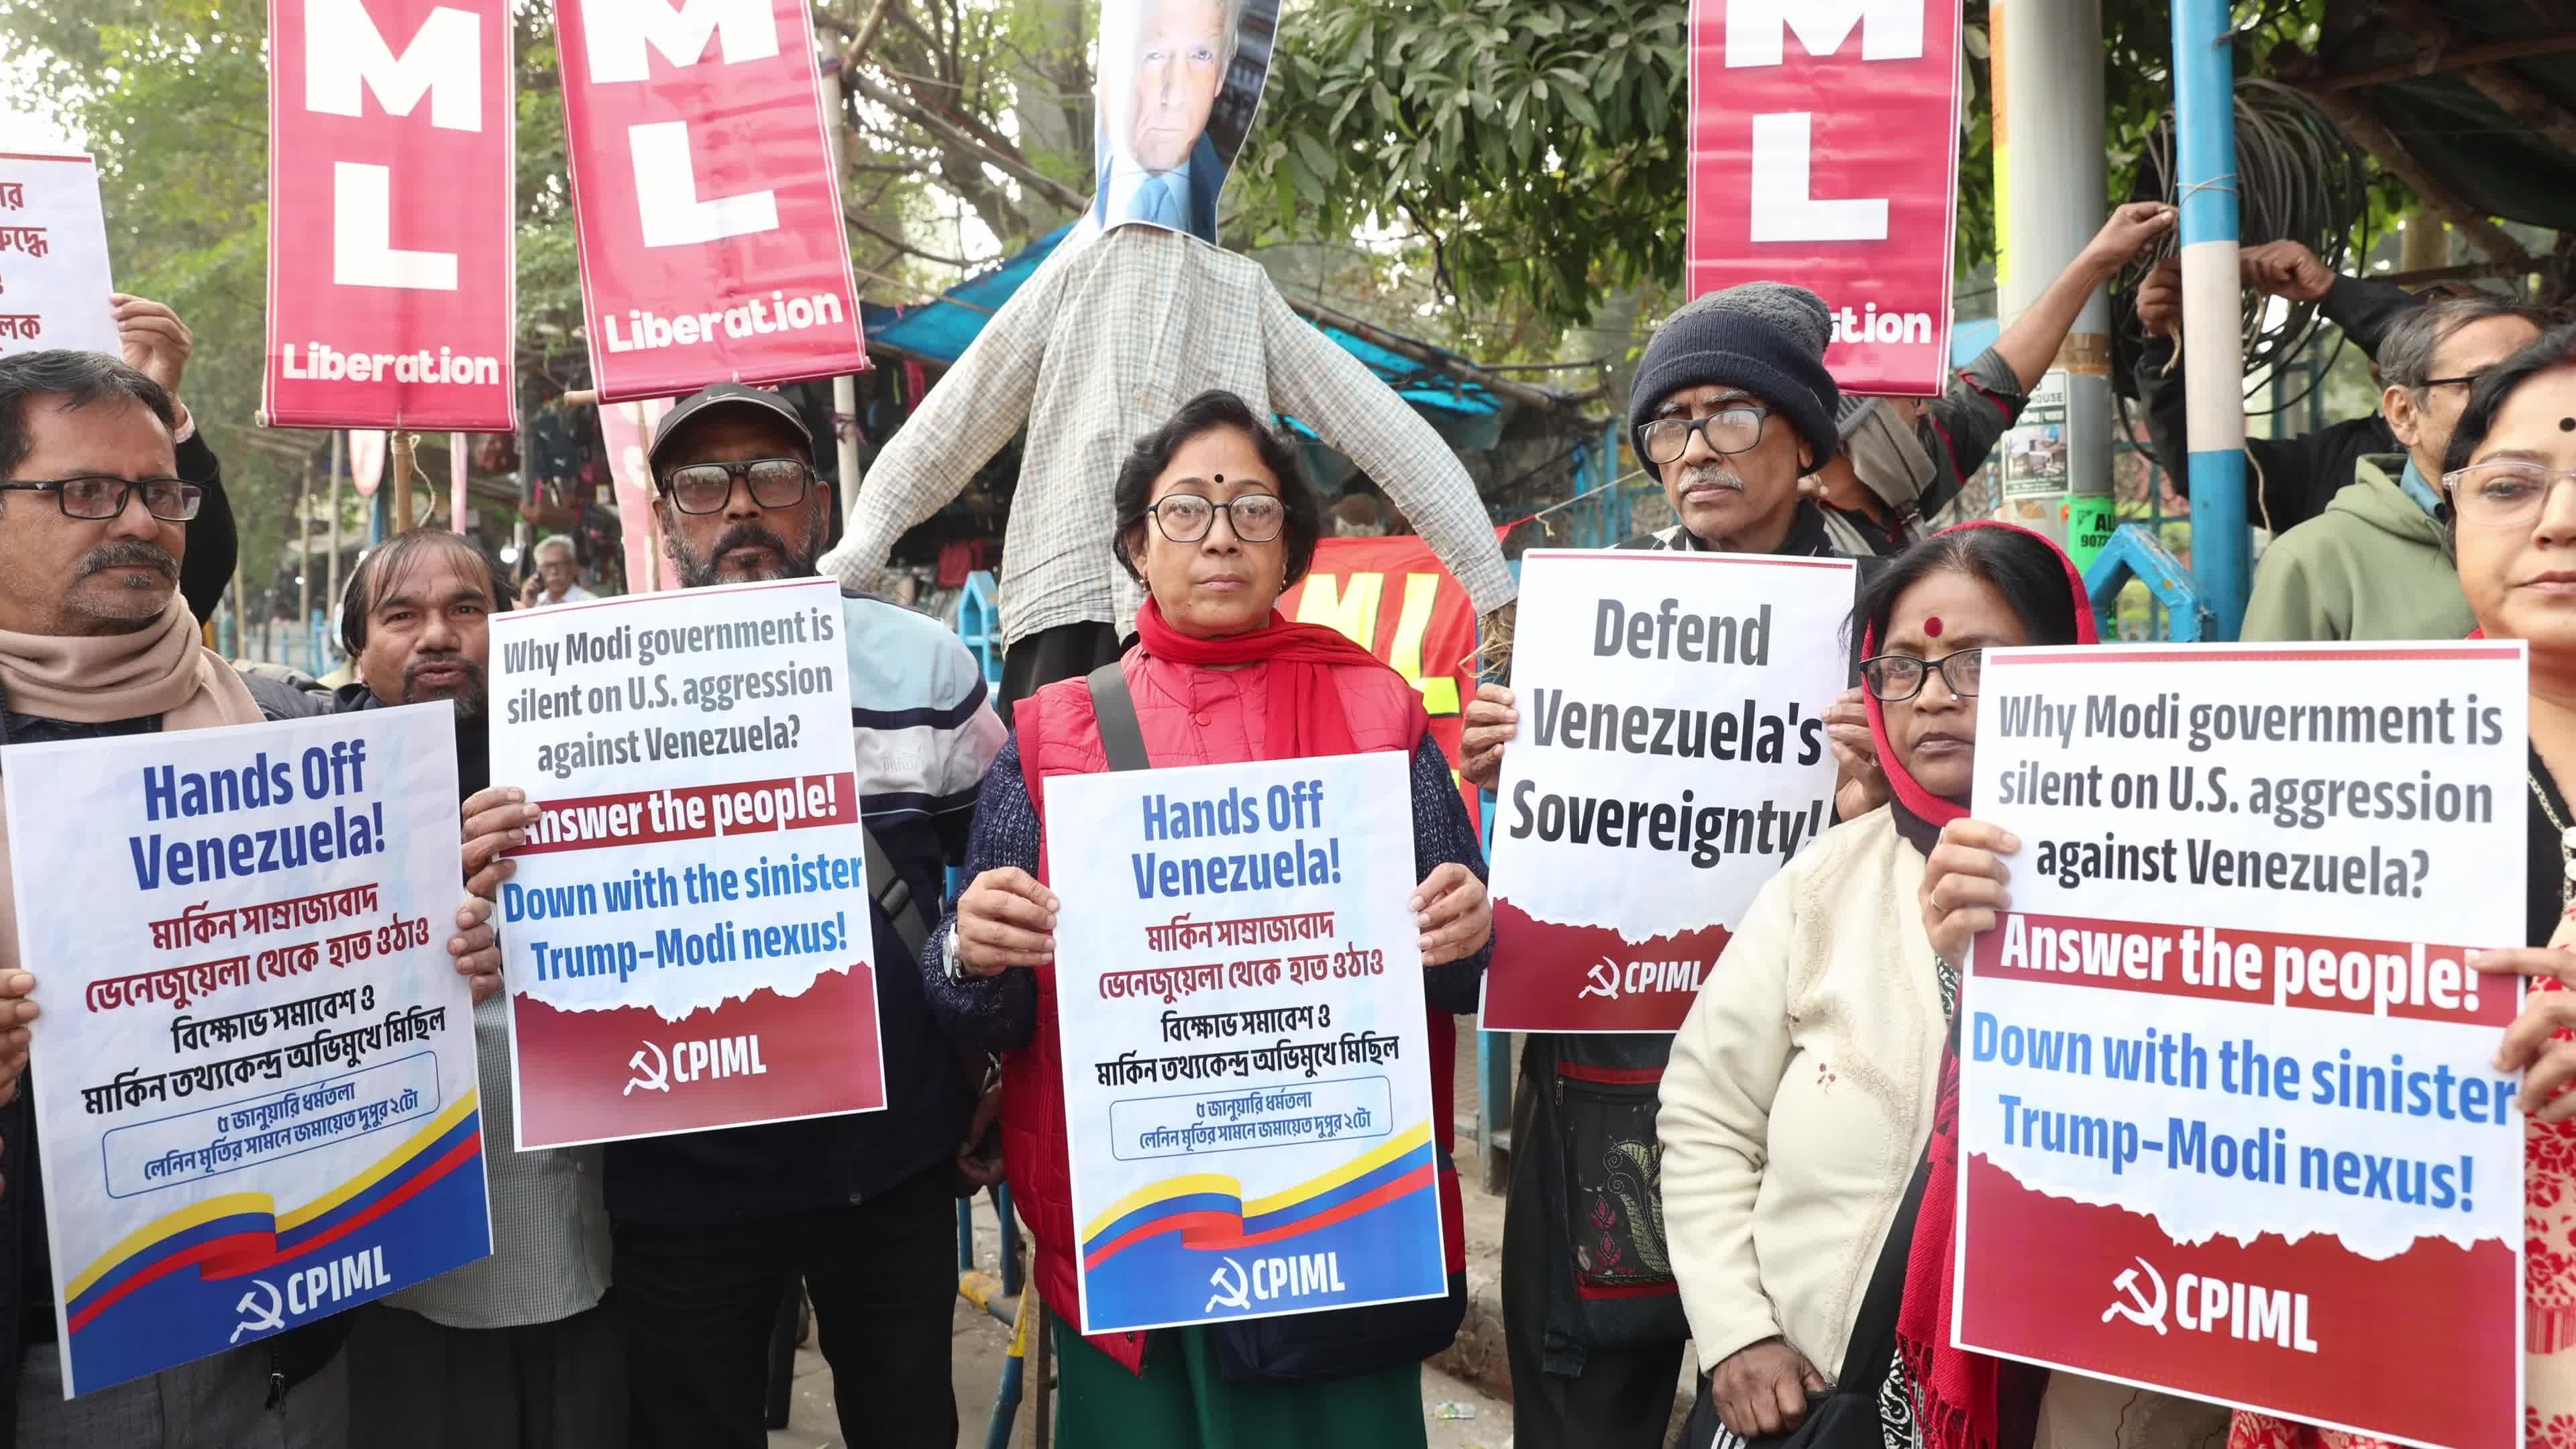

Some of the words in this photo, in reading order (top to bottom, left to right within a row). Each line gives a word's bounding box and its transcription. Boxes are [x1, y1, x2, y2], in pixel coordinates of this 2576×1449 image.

[304, 0, 482, 132] M
[628, 121, 779, 248] L
[1750, 112, 1888, 242] L
[334, 161, 458, 290] L
[604, 291, 843, 353] Liberation
[282, 343, 499, 386] Liberation
[504, 639, 559, 676] Why
[566, 625, 631, 665] Modi
[639, 612, 806, 667] government
[811, 607, 833, 641] is
[1594, 598, 1771, 665] Defend
[508, 684, 582, 724] silent
[588, 686, 622, 714] on
[629, 674, 677, 710] U.S.
[684, 661, 832, 712] aggression
[2000, 694, 2077, 749] Why
[2085, 693, 2179, 739] Modi
[2188, 698, 2455, 752] government
[2467, 694, 2502, 745] is
[539, 730, 641, 779] against
[645, 714, 800, 761] Venezuela?
[1535, 689, 1822, 766] Venezuela's
[144, 753, 293, 821] Hands
[303, 739, 366, 800] Off
[649, 790, 707, 833] the
[713, 775, 838, 838] people!
[1143, 788, 1259, 841] Hands
[1267, 780, 1323, 831] Off
[2000, 760, 2102, 807] silent
[2111, 768, 2157, 810] on
[2169, 766, 2238, 813] U.S.
[2249, 770, 2491, 829] aggression
[129, 802, 385, 890] Venezuela!
[1510, 780, 1823, 868] Sovereignty!
[503, 878, 597, 922] Down
[603, 867, 679, 913] with
[684, 865, 739, 904] the
[745, 853, 863, 899] sinister
[1132, 838, 1340, 899] Venezuela!
[2037, 832, 2177, 889] against
[2187, 839, 2428, 898] Venezuela?
[148, 900, 237, 950] মার্কিন
[239, 883, 378, 934] সাম্রাজ্যবাদ
[743, 912, 847, 959] nexus!
[1145, 912, 1213, 952] মার্কিন
[1214, 912, 1334, 946] সাম্রাজ্যবাদ
[86, 955, 250, 1012] ভেনেজুয়েলা
[257, 941, 319, 982] থেকে
[326, 930, 372, 968] হাত
[377, 912, 429, 955] ওঠাও
[1099, 964, 1224, 1004] ভেনেজুয়েলা
[1229, 959, 1281, 988] থেকে
[1287, 954, 1328, 985] হাত
[1333, 941, 1383, 978] ওঠাও
[1625, 960, 1705, 996] CPIML
[2001, 914, 2171, 981] Answer
[2180, 927, 2261, 990] the
[2280, 941, 2481, 1016] people!
[170, 1008, 268, 1053] বিক্ষোভ
[270, 989, 356, 1030] সমাবেশ
[361, 985, 374, 1010] ও
[1161, 1010, 1238, 1042] বিক্ষোভ
[1239, 1006, 1313, 1034] সমাবেশ
[1318, 1004, 1330, 1028] ও
[81, 1067, 166, 1114] মার্কিন
[169, 1049, 282, 1097] তথ্যকেন্দ্র
[284, 1024, 382, 1068] অভিমুখে
[384, 1006, 445, 1046] মিছিল
[673, 1035, 766, 1082] CPIML
[1095, 1050, 1157, 1086] মার্কিন
[1159, 1051, 1250, 1081] তথ্যকেন্দ্র
[1251, 1038, 1336, 1078] অভিমুখে
[1339, 1030, 1399, 1065] মিছিল
[1974, 1012, 2092, 1075] Down
[2104, 1028, 2207, 1089] with
[2219, 1040, 2300, 1100] the
[2312, 1049, 2517, 1125] sinister
[218, 1116, 229, 1133] ৫
[231, 1093, 300, 1130] জানুয়ারি
[303, 1082, 355, 1111] ধর্মতলা
[1140, 1126, 1179, 1148] লেনিন
[1180, 1121, 1216, 1151] মূর্তির
[1217, 1123, 1256, 1141] সামনে
[1257, 1117, 1313, 1139] জমায়েত
[1313, 1114, 1342, 1138] দুপুর
[1197, 1103, 1205, 1118] ৫
[1207, 1091, 1263, 1122] জানুয়ারি
[1266, 1087, 1311, 1111] ধর্মতলা
[145, 1150, 196, 1180] লেনিন
[197, 1136, 242, 1173] মূর্তির
[244, 1127, 291, 1154] সামনে
[293, 1110, 355, 1143] জমায়েত
[358, 1099, 388, 1131] দুপুর
[2300, 1144, 2473, 1212] nexus!
[288, 1246, 390, 1314] CPIML
[1253, 1252, 1345, 1299] CPIML
[2176, 1274, 2317, 1352] CPIML
